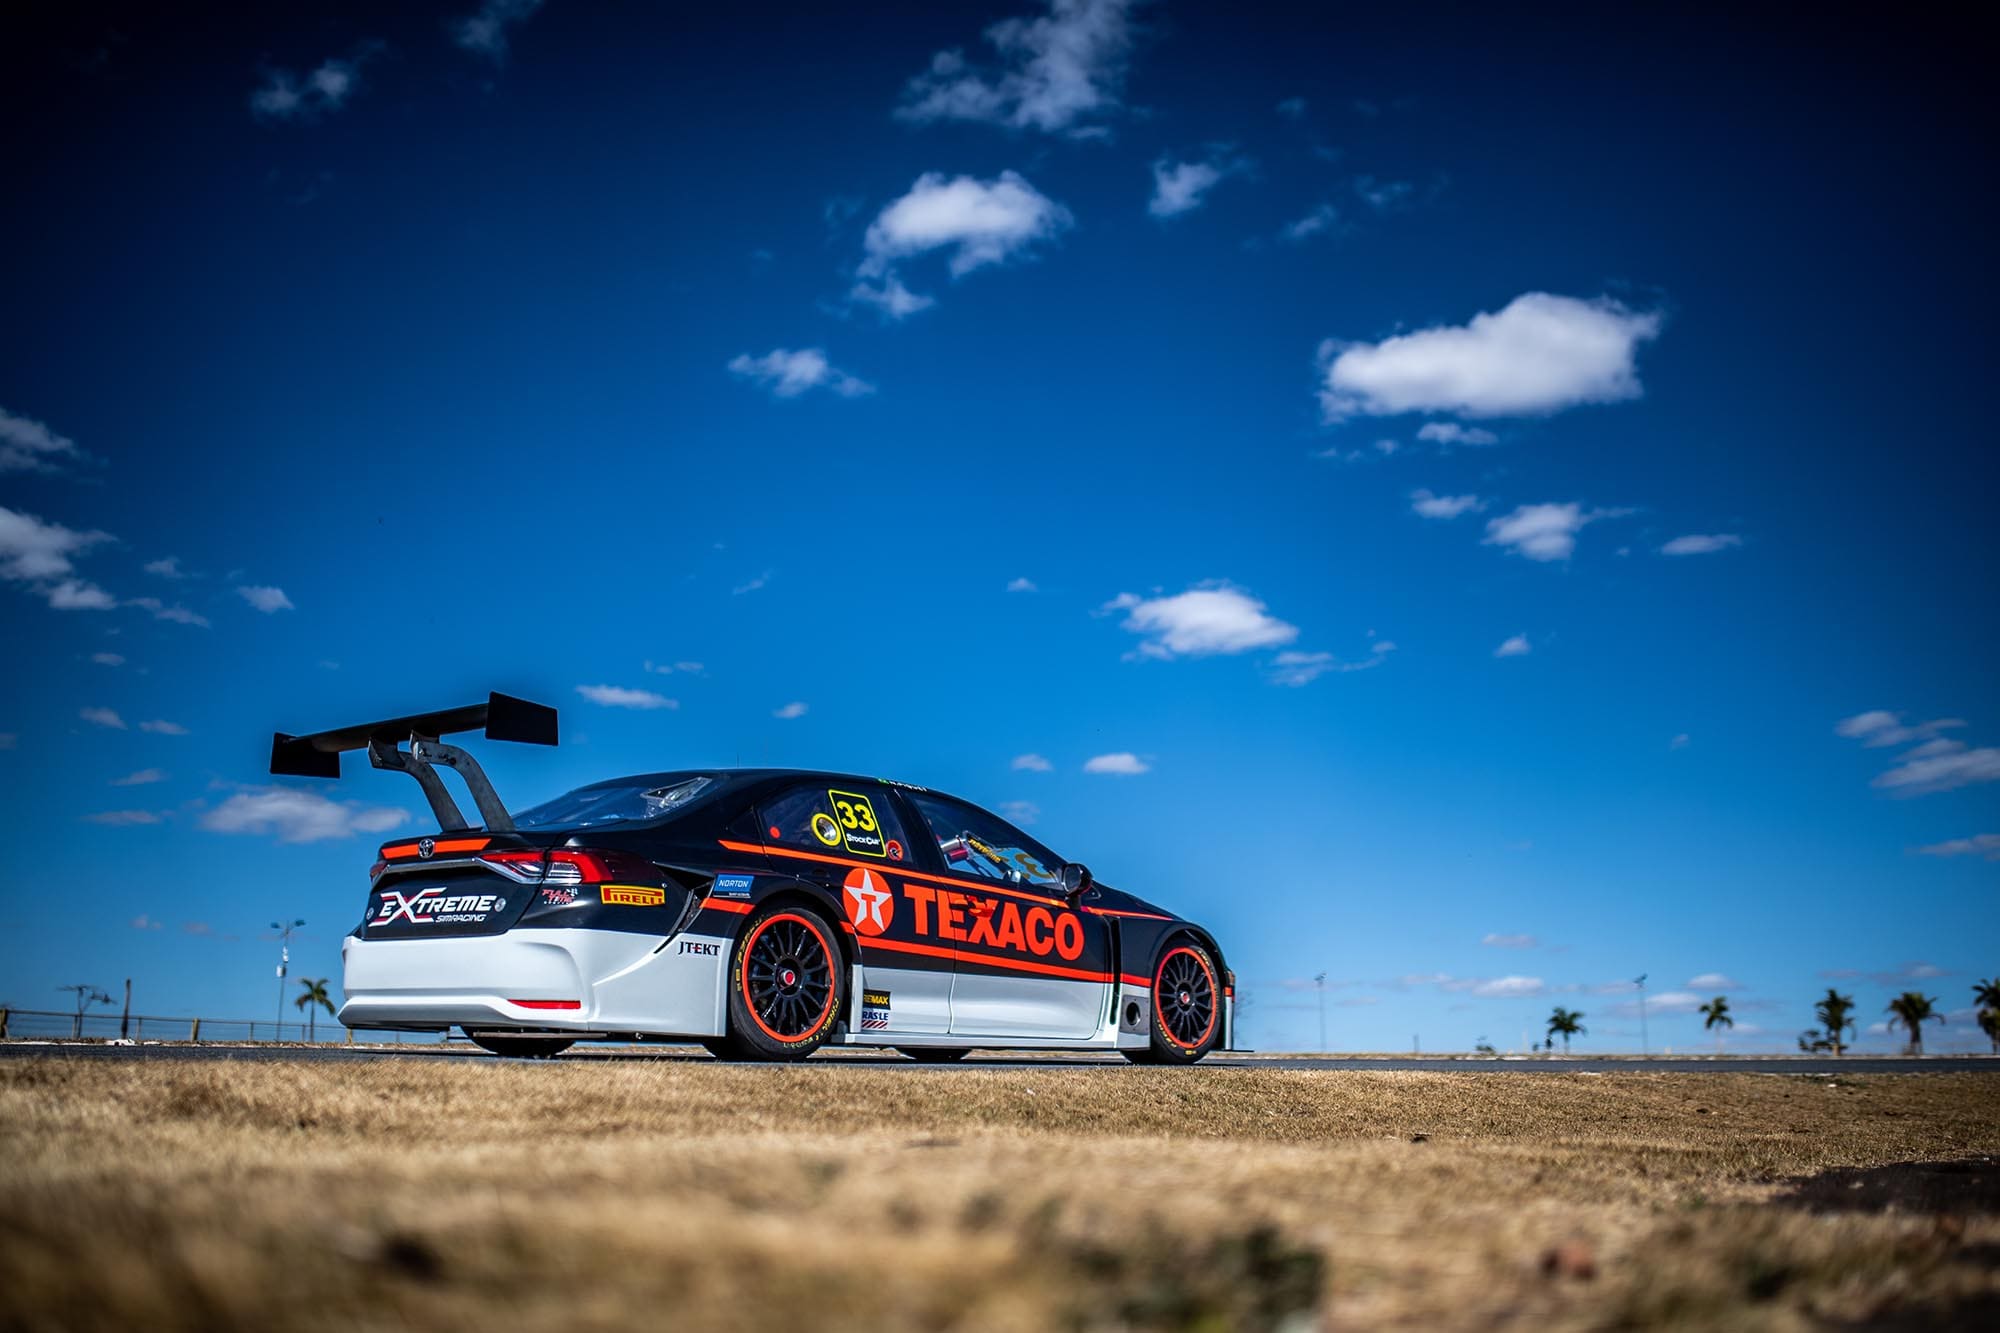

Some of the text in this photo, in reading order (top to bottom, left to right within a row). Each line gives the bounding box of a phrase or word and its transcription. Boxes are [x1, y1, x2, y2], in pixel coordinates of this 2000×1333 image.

[837, 801, 876, 831] 33
[718, 879, 749, 888] NORTON
[368, 887, 498, 927] EXTREME
[603, 888, 663, 905] PIRELLI
[903, 883, 1085, 961] TEXACO
[678, 941, 721, 956] JTEKT
